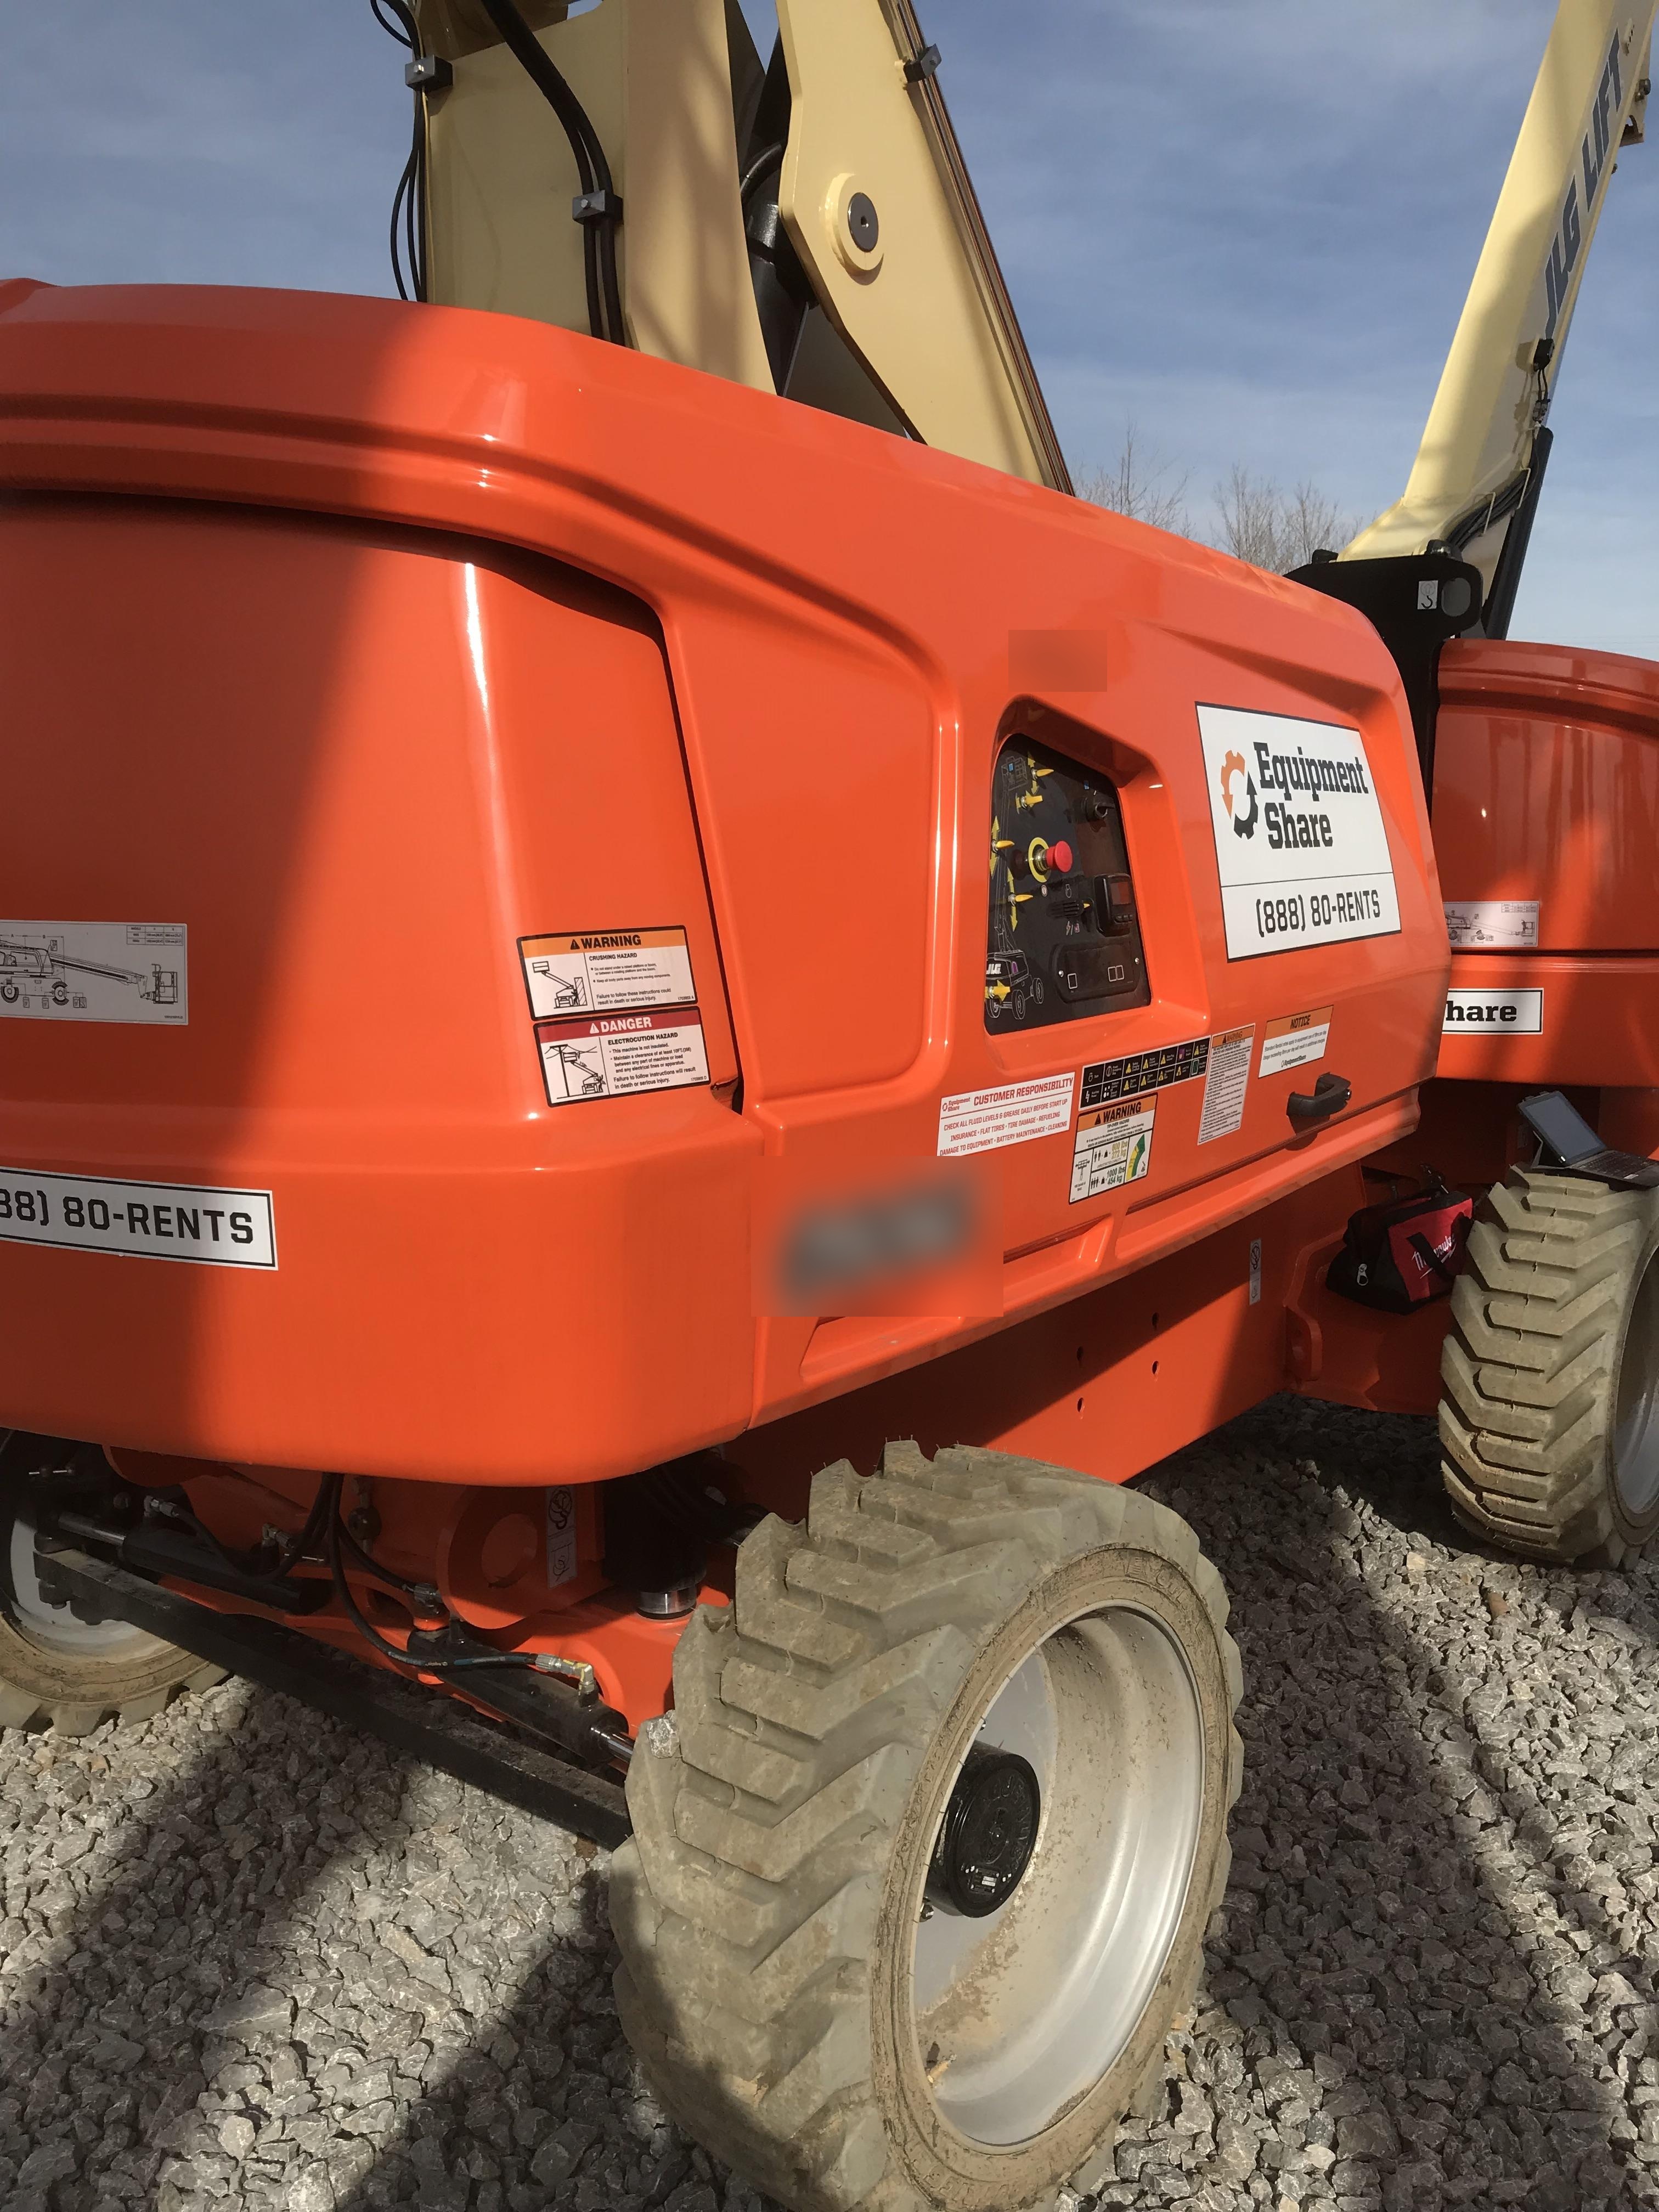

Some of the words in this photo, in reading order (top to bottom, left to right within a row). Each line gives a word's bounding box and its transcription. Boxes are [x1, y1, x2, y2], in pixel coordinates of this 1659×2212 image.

[1544, 174, 1581, 339] JLG
[1582, 25, 1622, 212] LIFT
[1253, 742, 1369, 801] Equipment
[1265, 802, 1333, 849] Share
[1256, 894, 1305, 937] (888)
[1311, 889, 1380, 927] 80-RENTS
[581, 935, 641, 949] WARNING
[600, 1017, 652, 1032] DANGER
[1290, 1014, 1311, 1029] NOTICE
[608, 1035, 654, 1045] ELECTROCUTION
[949, 1097, 970, 1106] Equipment
[974, 1090, 1014, 1106] CUSTOMER
[1017, 1077, 1073, 1097] RESPONSIBILITY
[944, 1122, 961, 1131] CHECK
[969, 1117, 982, 1125] FLUID
[983, 1114, 998, 1122] LEVELS
[1003, 1109, 1020, 1118] GREASE
[1021, 1106, 1034, 1114] DAILY
[1034, 1103, 1048, 1111] BEFORE
[951, 1130, 977, 1141] INSURANCE
[980, 1127, 991, 1135] FLAT
[991, 1124, 1005, 1132] TIRES
[1019, 1117, 1036, 1126] DAMAGE
[1039, 1111, 1060, 1121] REFUELING
[1103, 1102, 1141, 1123] WARNING
[940, 1146, 959, 1156] DAMAGE
[967, 1138, 994, 1150] EQUIPMENT
[996, 1133, 1015, 1143] BATTERY
[1016, 1126, 1045, 1138] MAINTENANCE
[1048, 1121, 1067, 1130] CLEANING
[1107, 1167, 1117, 1178] 1000
[63, 1197, 253, 1243] 80-RENTS
